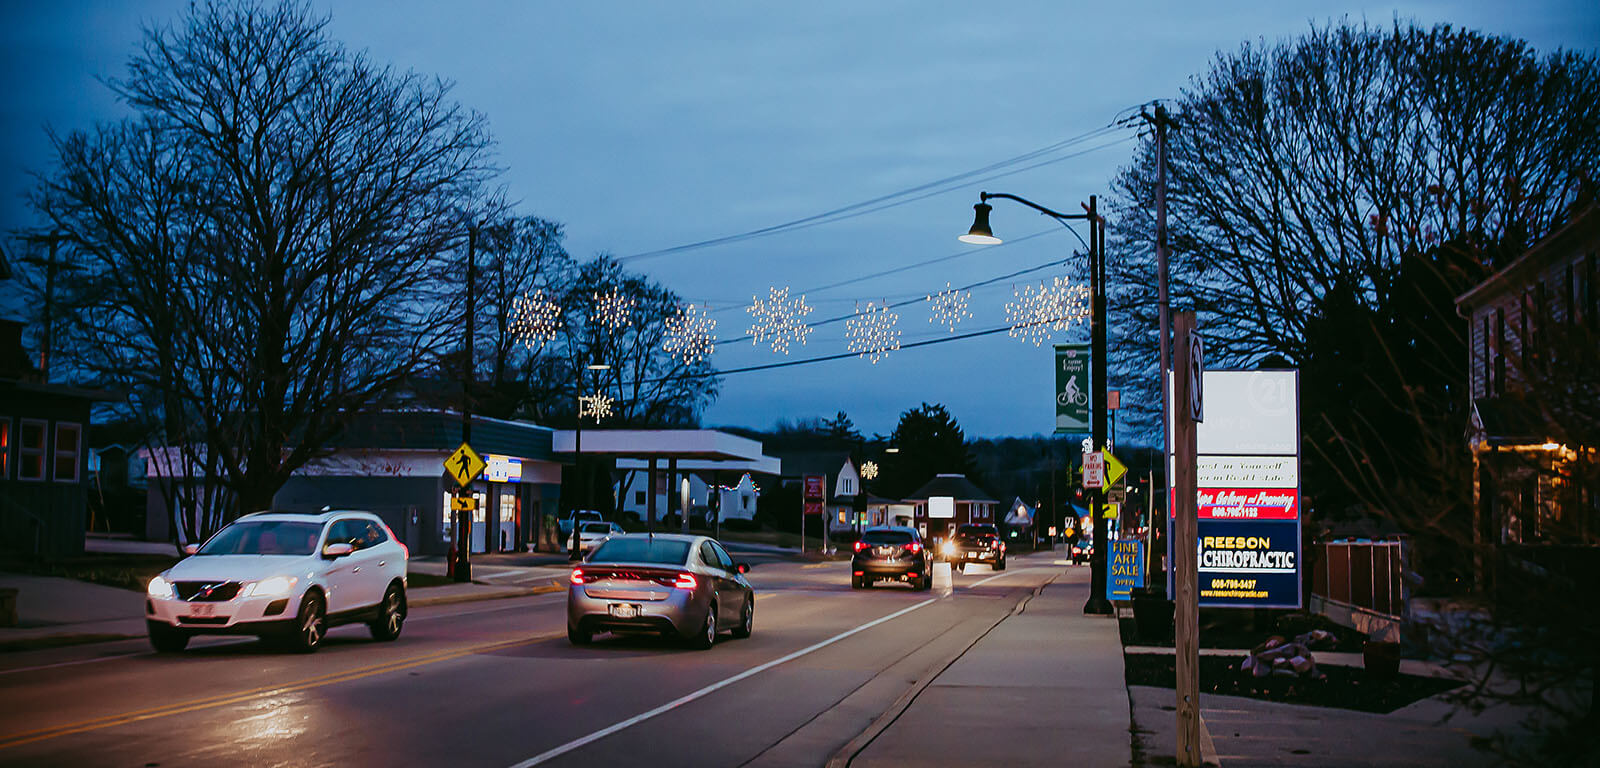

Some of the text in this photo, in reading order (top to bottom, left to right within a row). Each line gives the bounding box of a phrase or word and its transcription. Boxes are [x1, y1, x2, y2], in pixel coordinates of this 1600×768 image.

[1257, 491, 1294, 512] Framing
[1113, 542, 1138, 552] FINE
[1203, 536, 1271, 549] REESON
[1114, 553, 1137, 564] ART
[1203, 551, 1295, 568] CHIROPRACTIC
[1112, 565, 1139, 576] SALE
